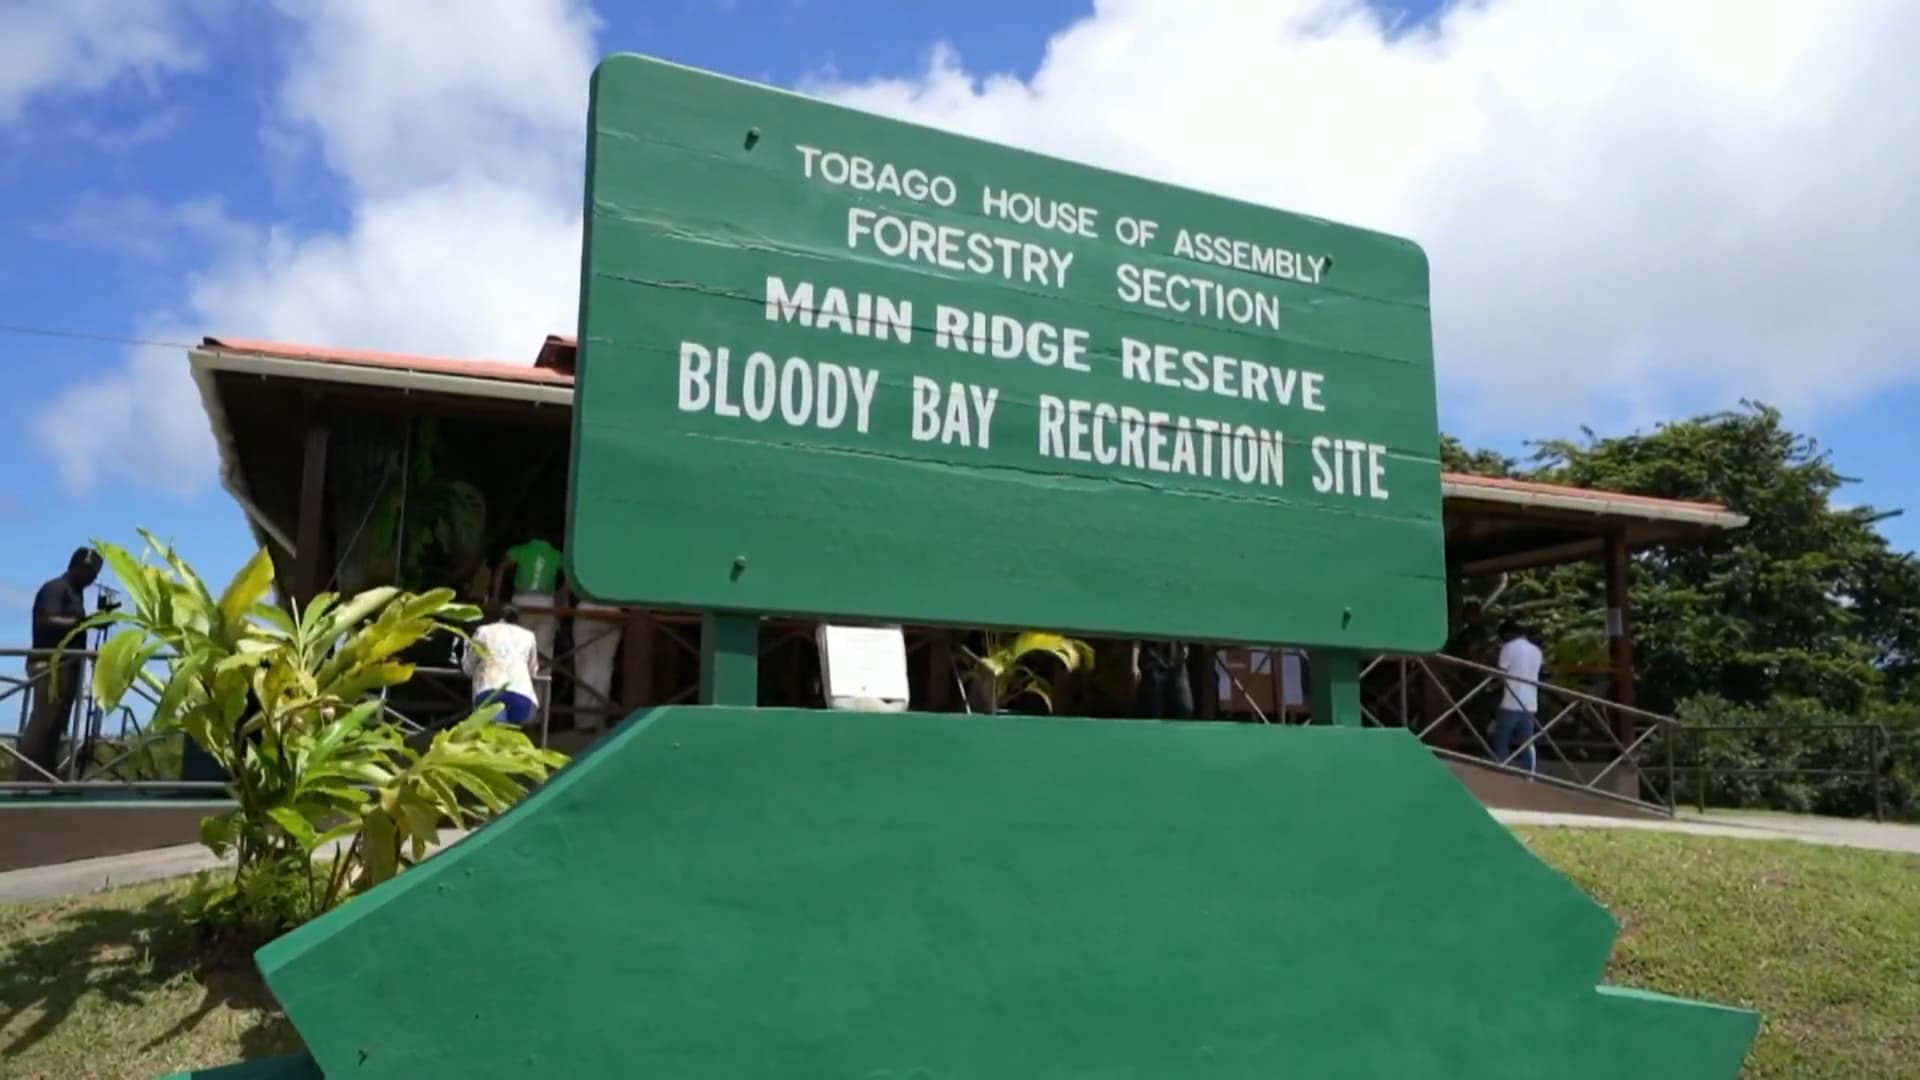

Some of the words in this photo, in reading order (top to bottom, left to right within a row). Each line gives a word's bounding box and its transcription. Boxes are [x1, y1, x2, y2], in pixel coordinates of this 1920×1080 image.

[795, 144, 957, 207] TOBAGO
[983, 185, 1098, 238] HOUSE
[1115, 216, 1159, 248] OF
[1174, 229, 1324, 283] ASSEMBLY
[847, 208, 1074, 289] FORESTRY
[1116, 264, 1280, 330] SECTION
[766, 276, 912, 344] MAIN
[936, 304, 1091, 372] RIDGE
[1121, 337, 1325, 411] RESERVE
[679, 341, 879, 432] BLOODY
[912, 376, 999, 448] BAY
[1038, 394, 1284, 487] RECREATION
[1312, 436, 1388, 499] SITE
